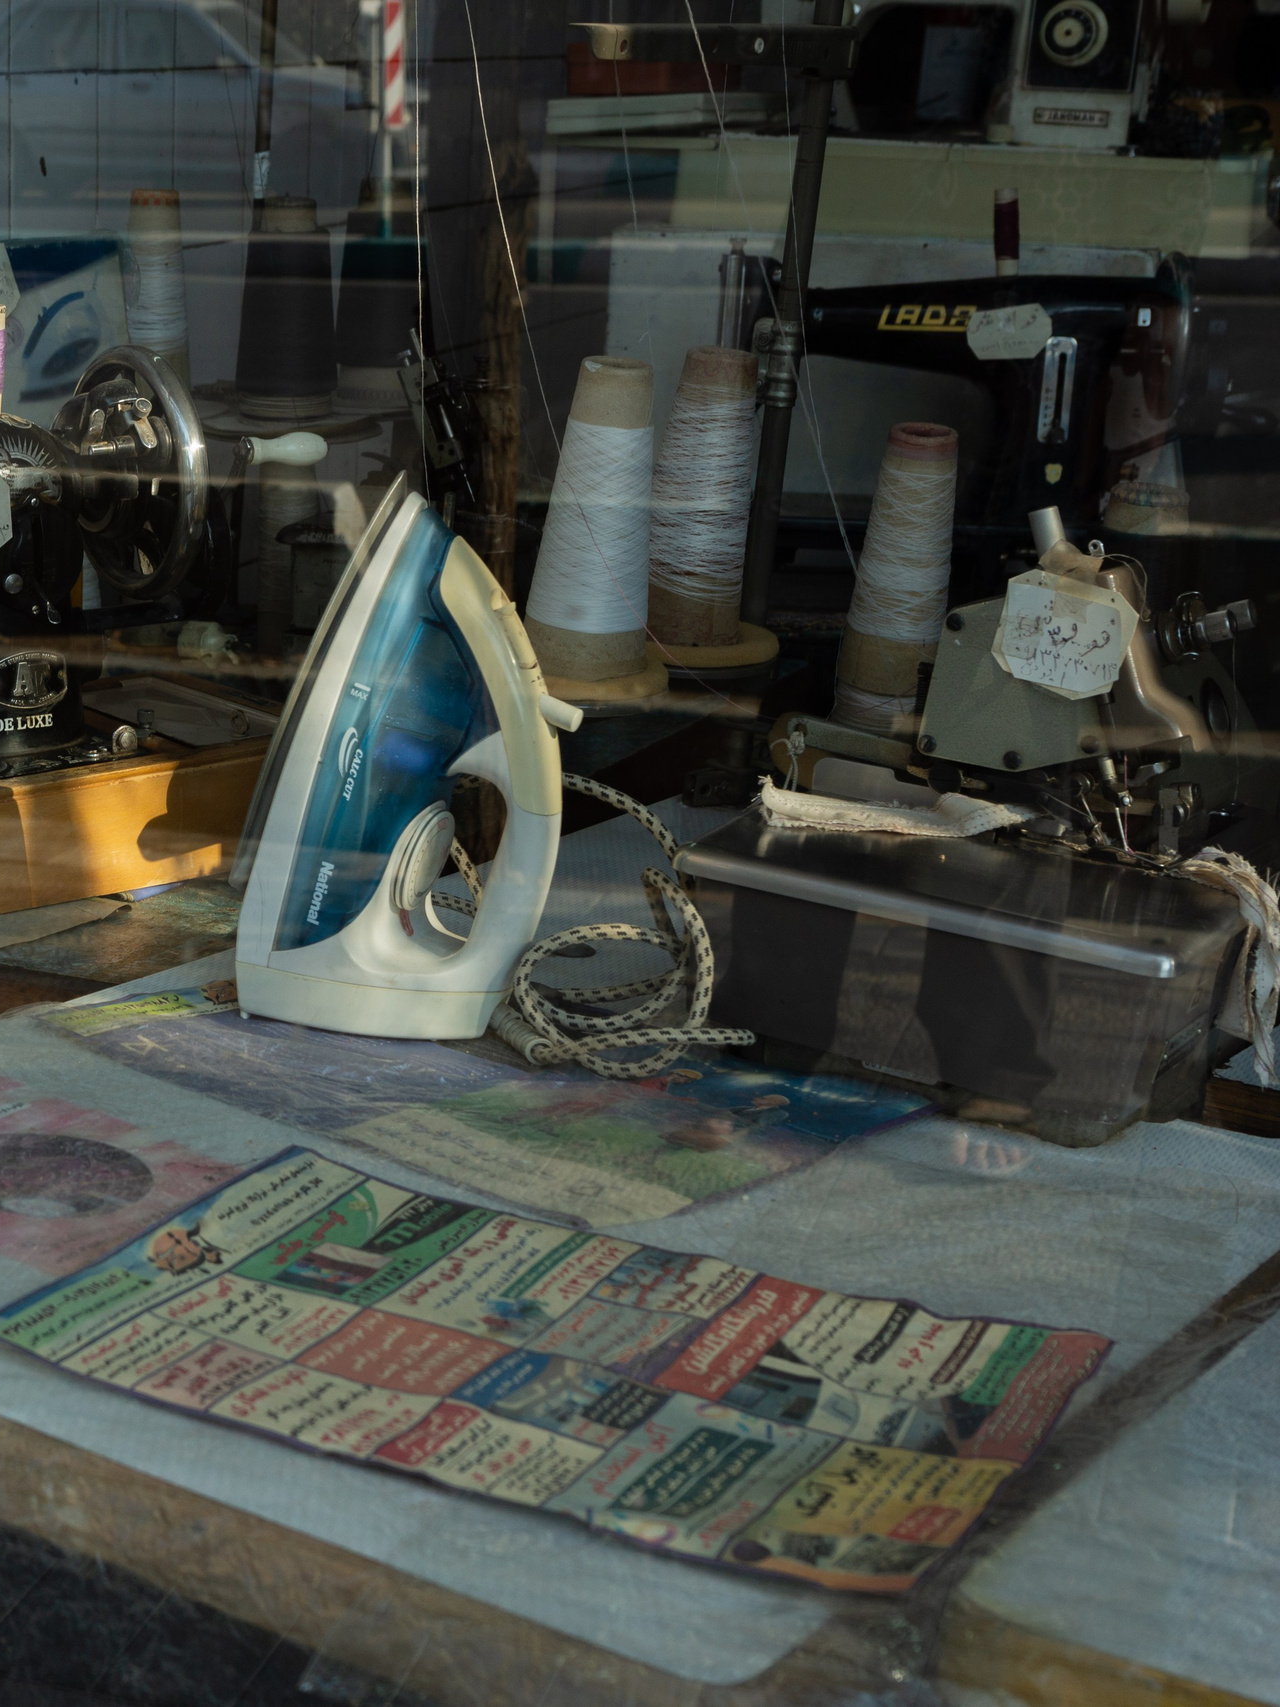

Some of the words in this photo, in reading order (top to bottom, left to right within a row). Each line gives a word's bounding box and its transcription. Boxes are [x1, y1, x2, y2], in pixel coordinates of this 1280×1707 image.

[877, 303, 977, 332] LADA
[350, 688, 368, 702] MAX
[16, 713, 54, 731] LUXE
[349, 748, 365, 779] CALC
[342, 779, 356, 802] CUT
[306, 861, 335, 927] National
